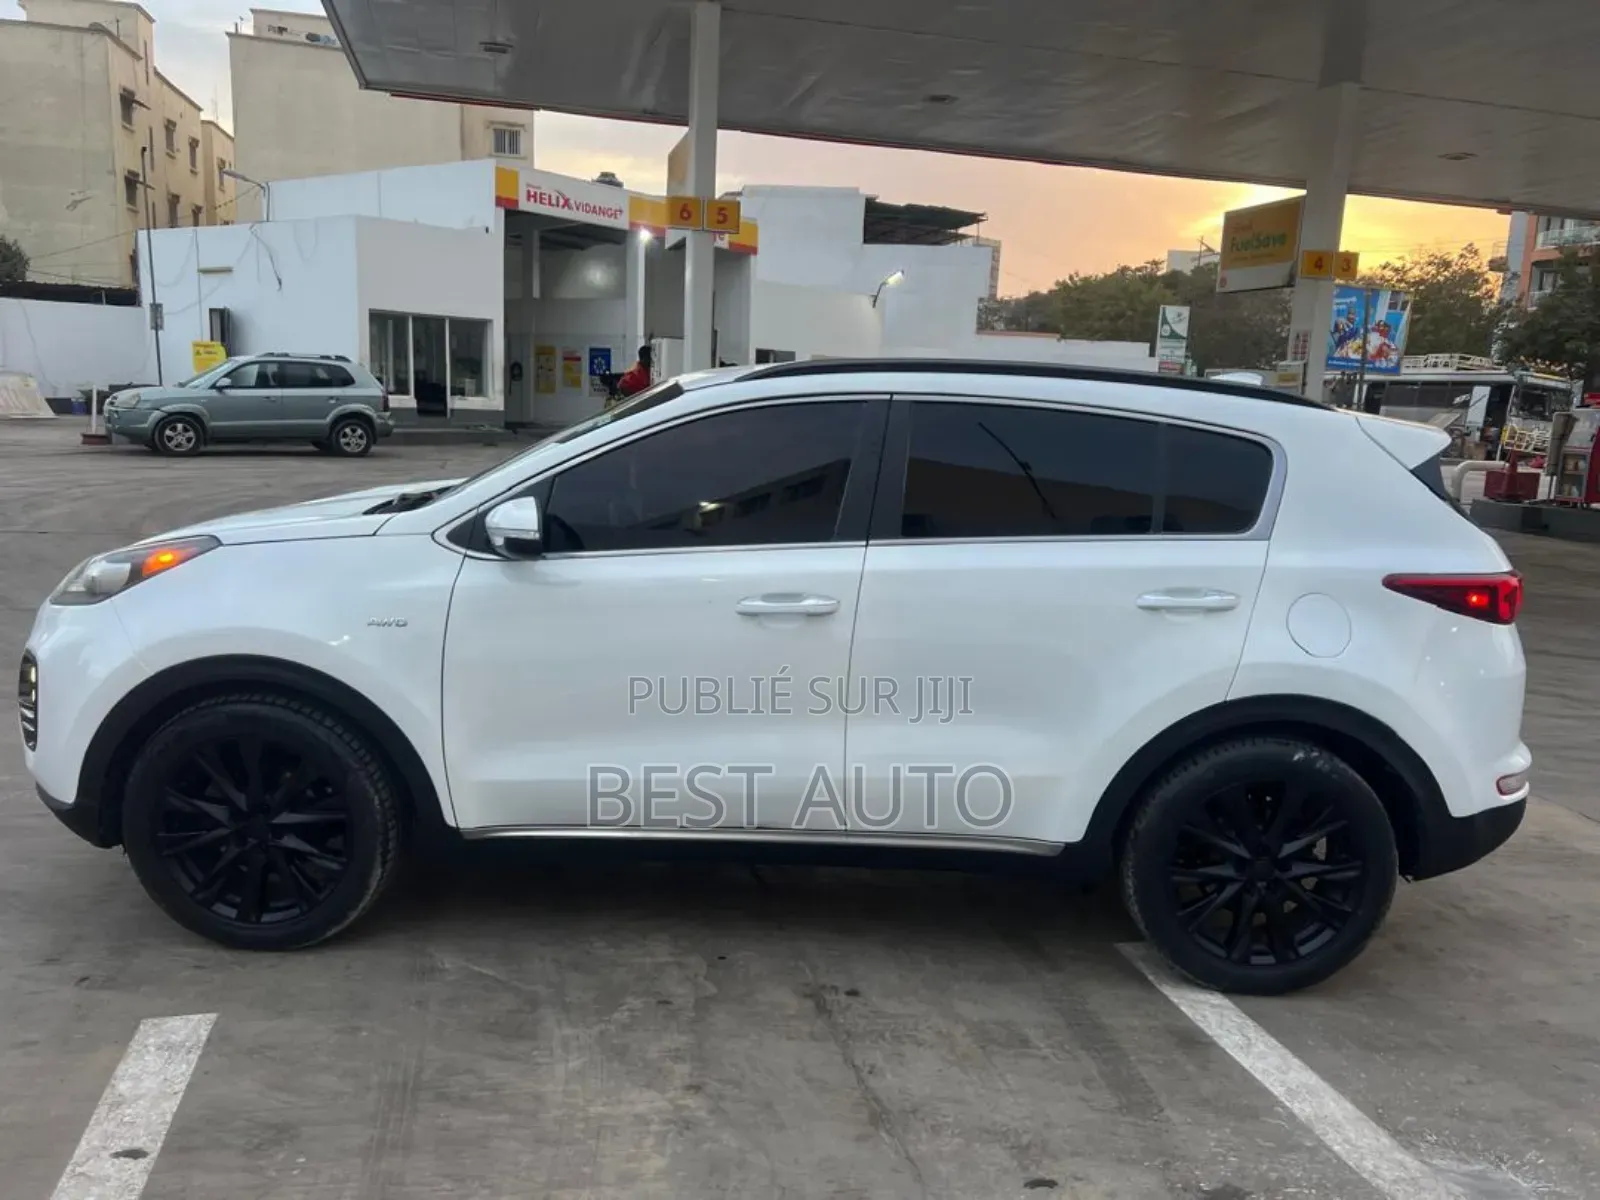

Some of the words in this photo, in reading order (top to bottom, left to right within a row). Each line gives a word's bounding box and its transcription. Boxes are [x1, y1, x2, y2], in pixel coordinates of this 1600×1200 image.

[526, 188, 573, 210] HELIX
[680, 203, 691, 221] 6
[716, 206, 728, 225] 5
[1314, 256, 1323, 272] 4
[1341, 257, 1352, 272] 3
[367, 616, 408, 628] AWD
